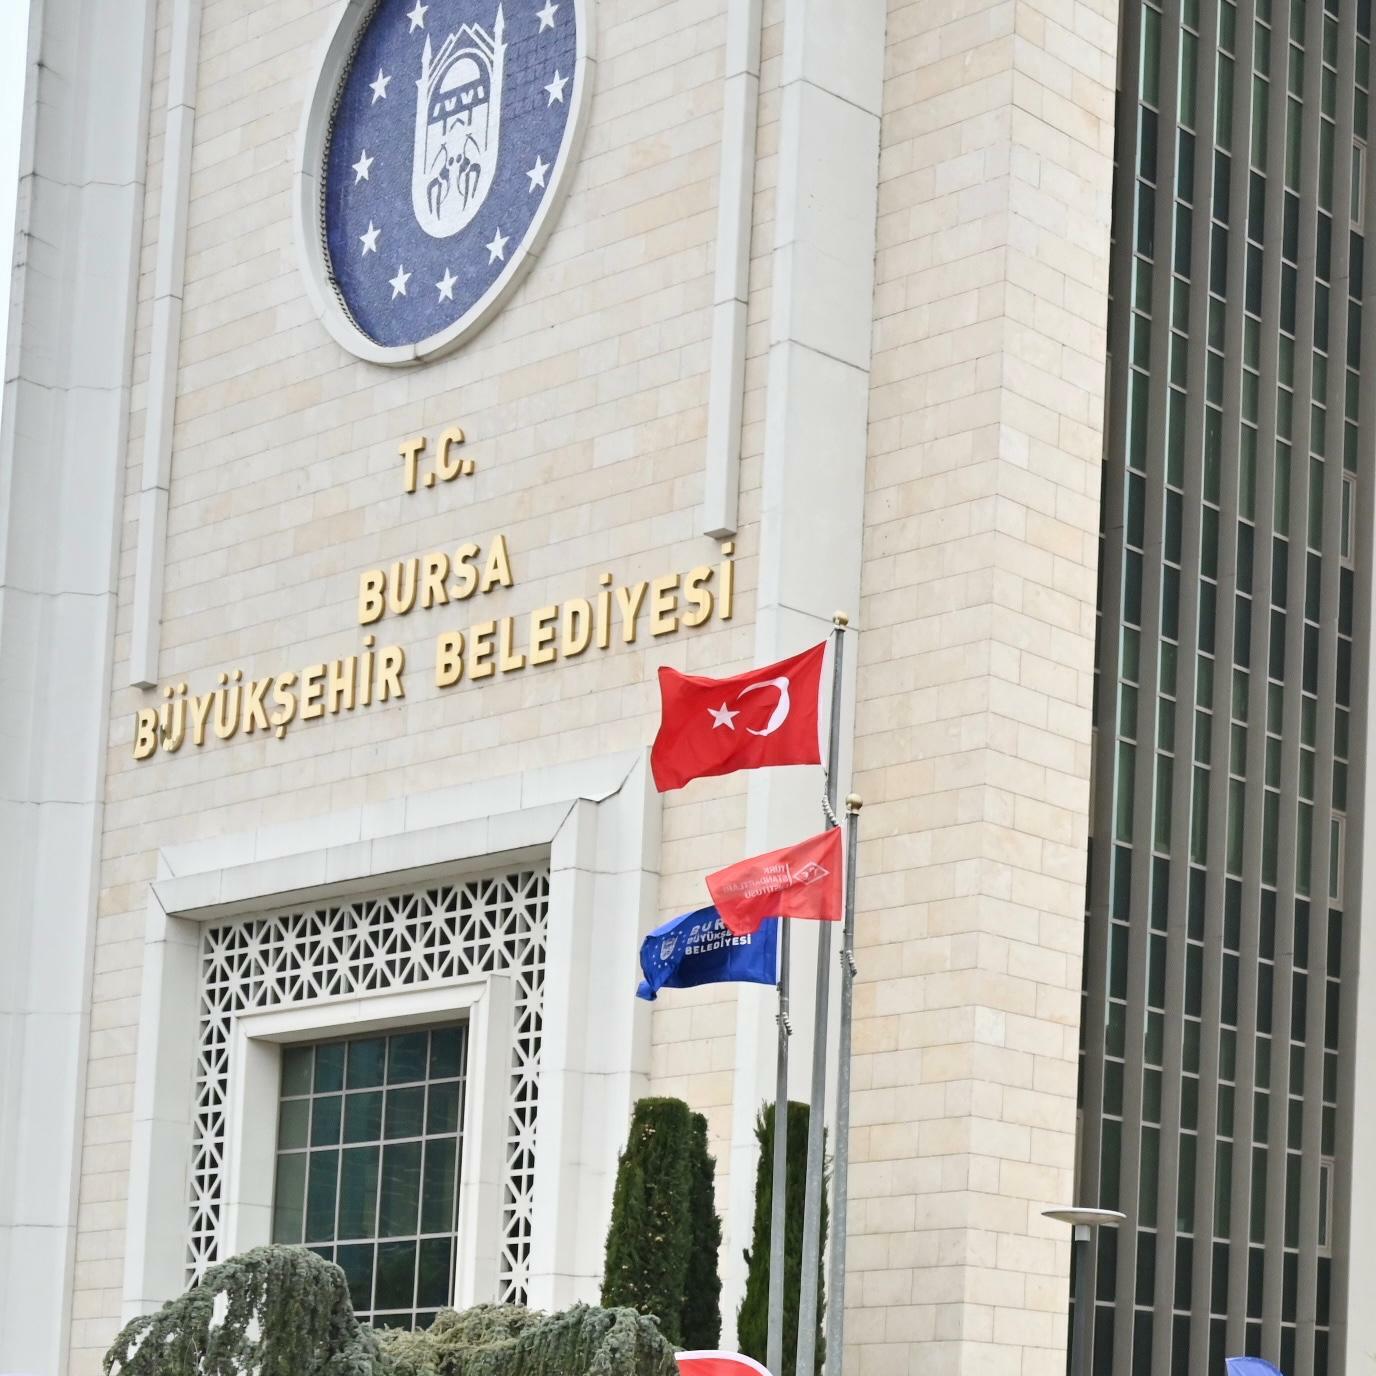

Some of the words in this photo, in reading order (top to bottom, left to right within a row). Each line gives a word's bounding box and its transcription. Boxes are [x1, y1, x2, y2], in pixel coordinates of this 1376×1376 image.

[400, 427, 475, 493] T.C.
[359, 535, 514, 626] BURSA
[132, 636, 406, 760] BÜYÜKŞEHİR
[435, 542, 735, 688] BELEDİYESİ
[685, 932, 751, 956] BELEDİYESİ
[690, 916, 725, 936] BUR
